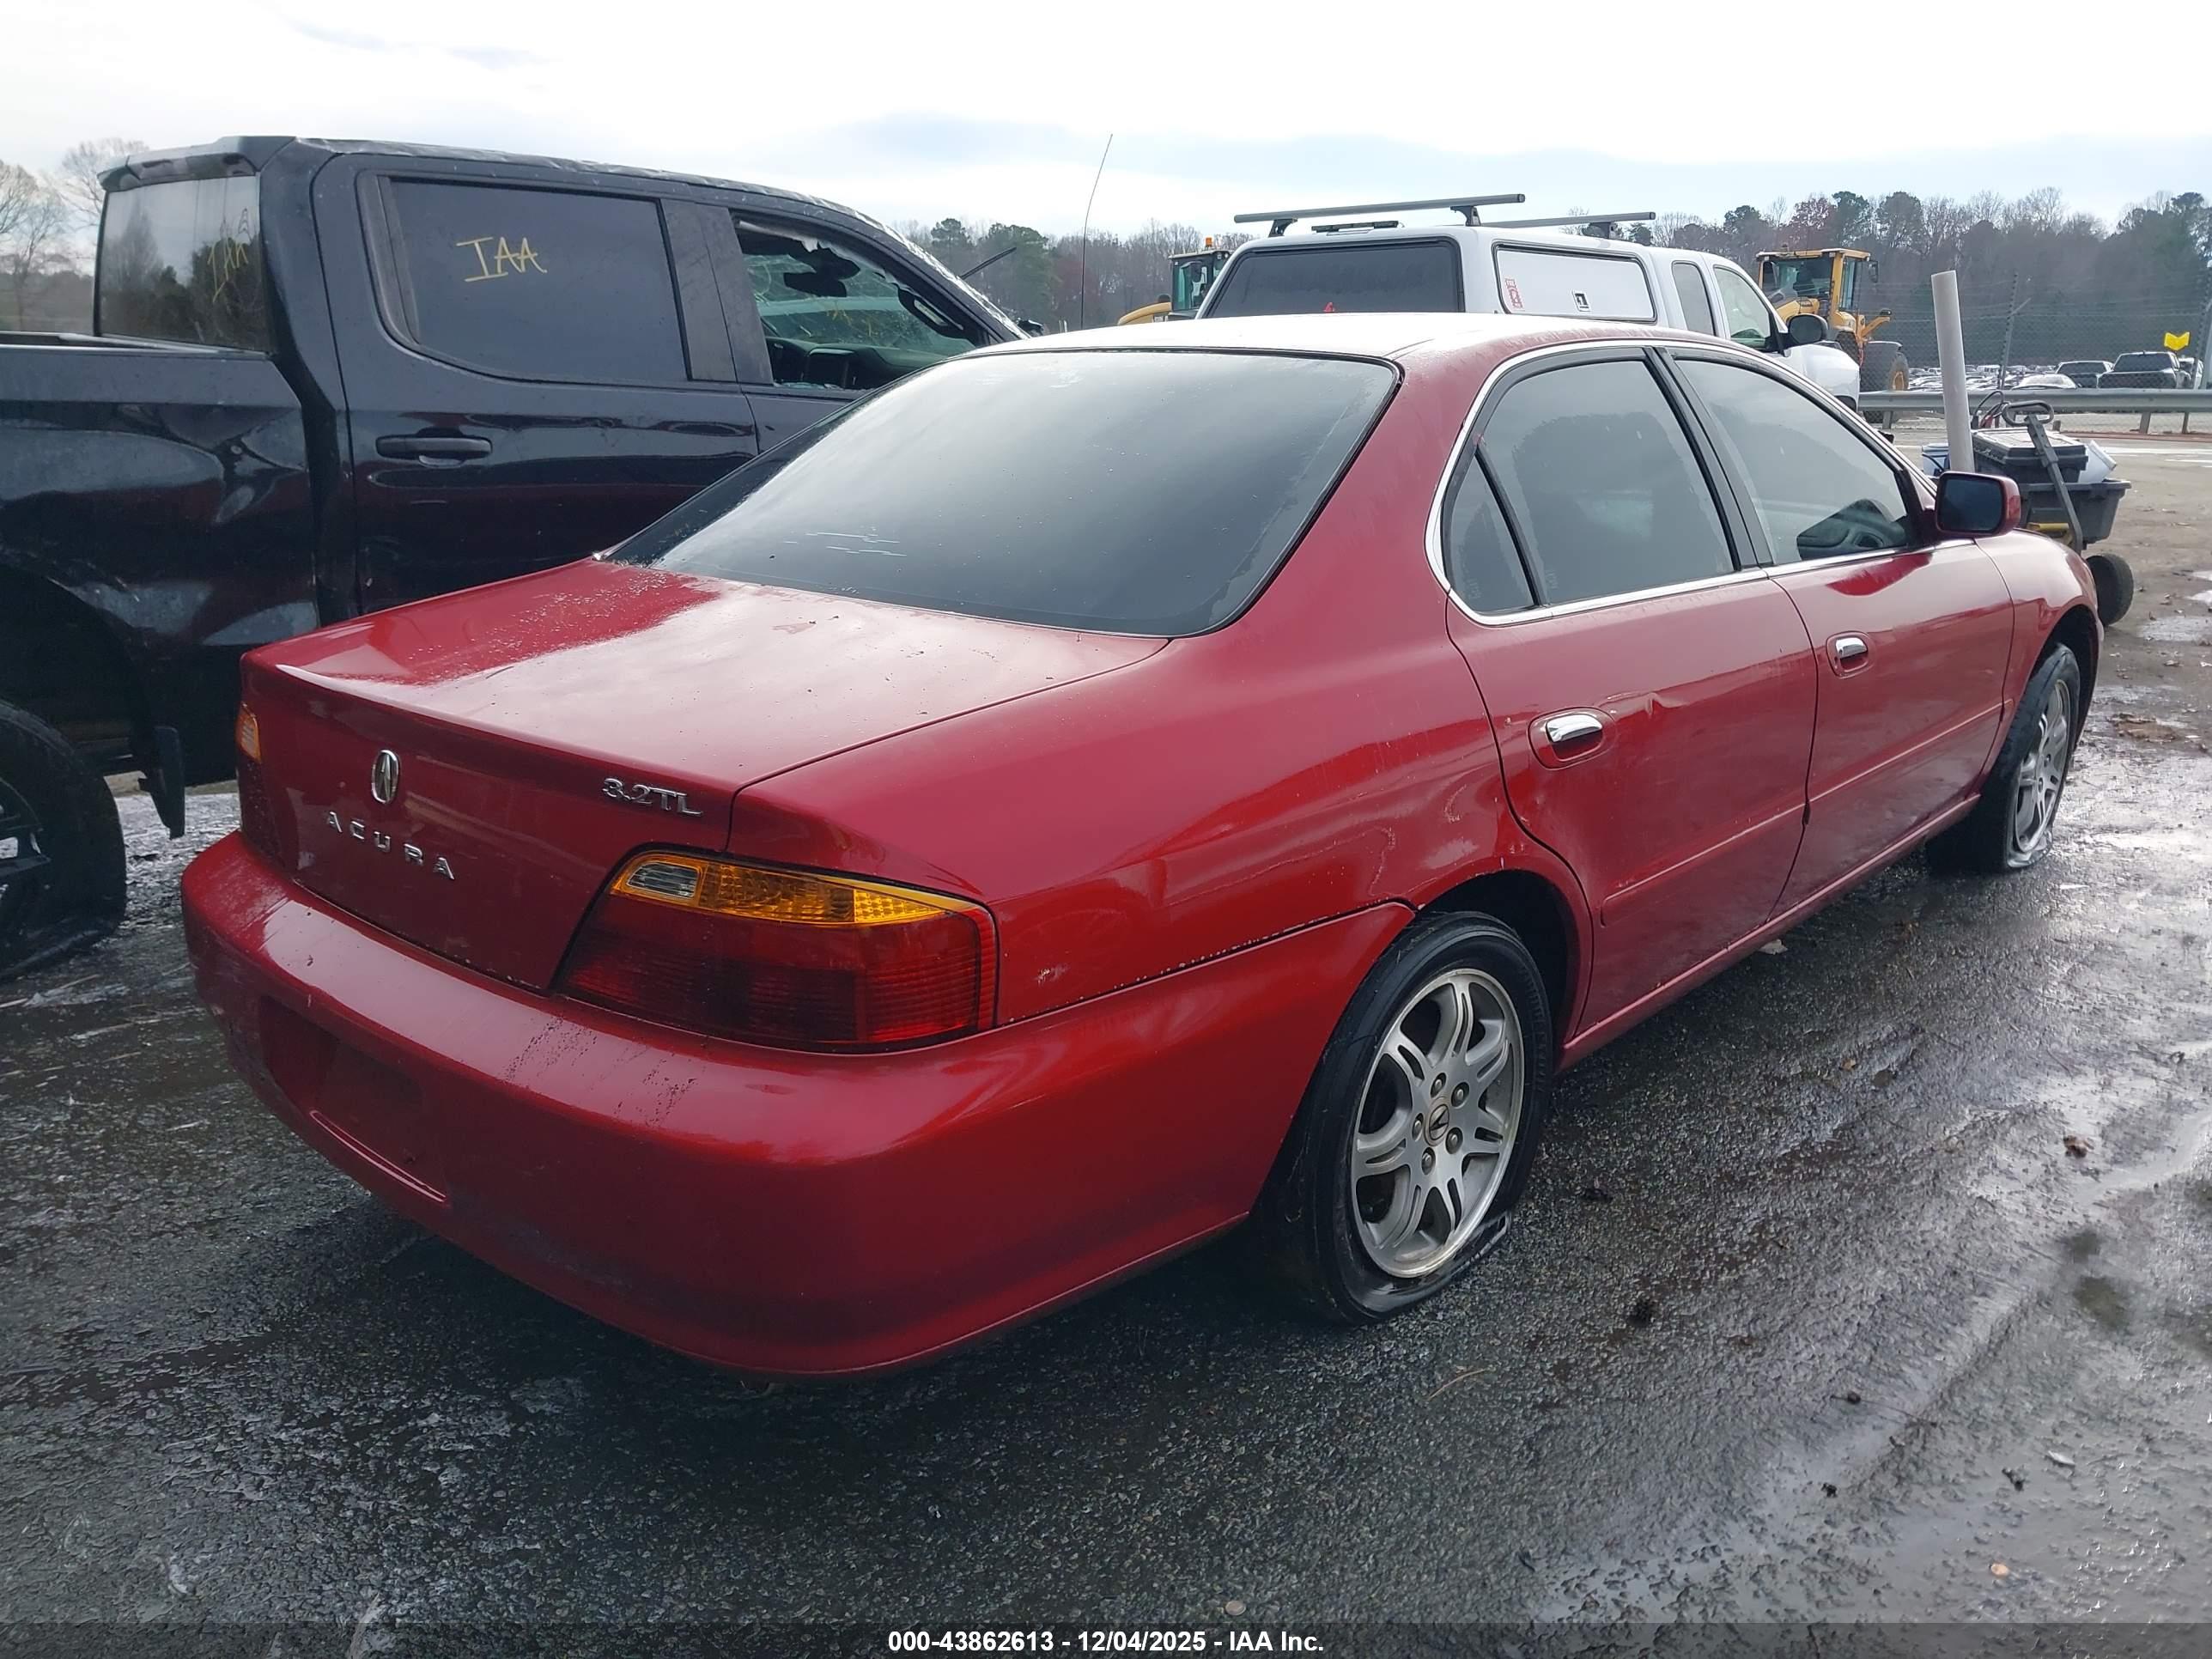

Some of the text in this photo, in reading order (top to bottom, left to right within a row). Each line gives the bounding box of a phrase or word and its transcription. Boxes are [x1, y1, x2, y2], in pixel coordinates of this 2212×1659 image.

[456, 236, 548, 282] IAA
[602, 777, 703, 816] 3.2TL
[327, 811, 455, 880] ACURA
